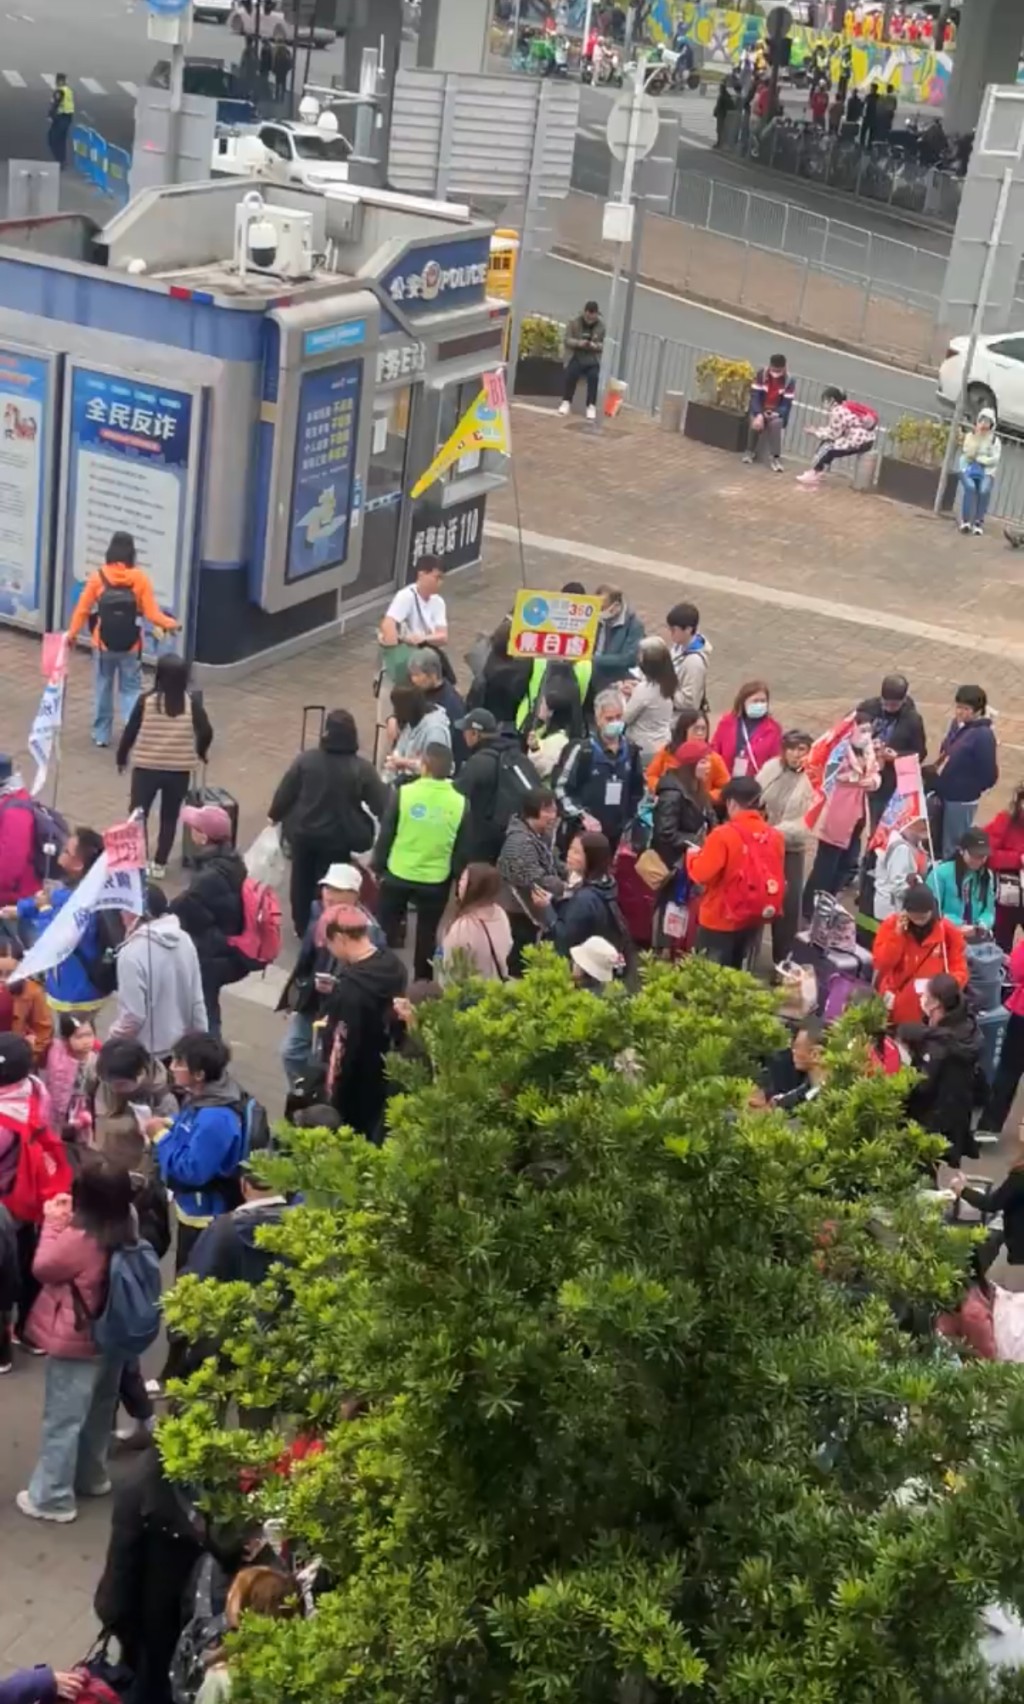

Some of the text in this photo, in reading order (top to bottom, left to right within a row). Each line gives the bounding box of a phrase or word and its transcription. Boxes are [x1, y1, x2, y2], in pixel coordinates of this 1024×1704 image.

[390, 263, 487, 299] 公安 POLICE
[85, 396, 177, 441] 全民反诈
[460, 508, 479, 548] 110
